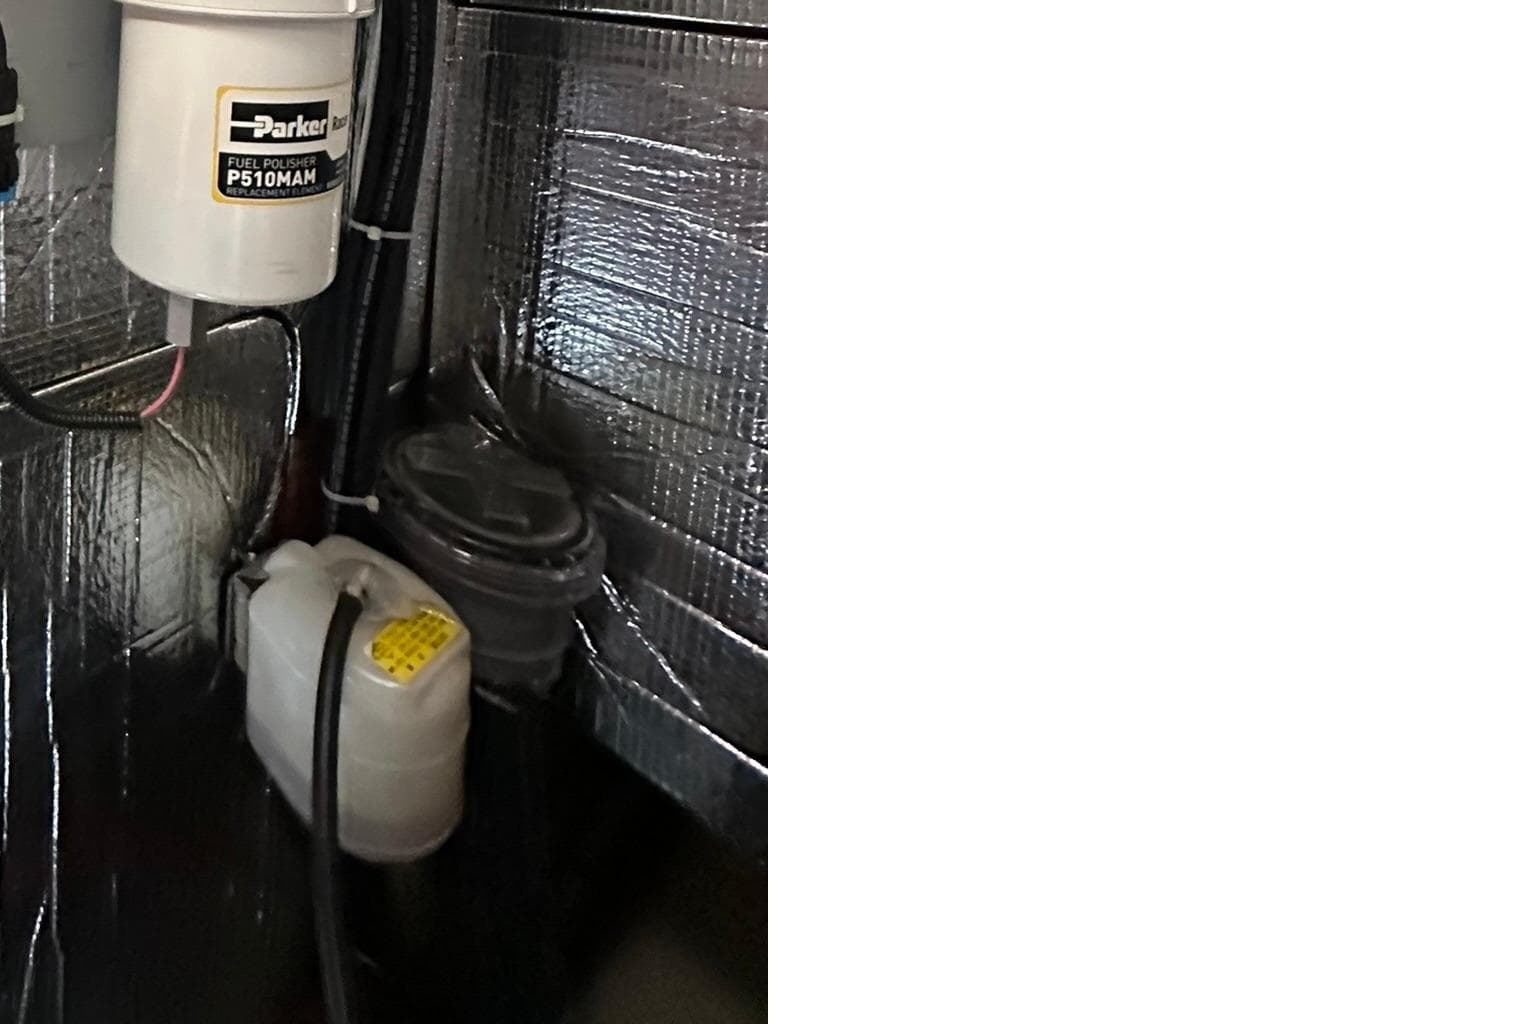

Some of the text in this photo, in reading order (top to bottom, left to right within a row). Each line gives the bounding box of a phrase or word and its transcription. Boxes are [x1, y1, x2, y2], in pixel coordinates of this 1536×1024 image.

[252, 114, 329, 139] Parker
[228, 156, 317, 169] FUEL POLISHER
[226, 167, 317, 188] P510MAM
[226, 187, 291, 198] REPLACEMENT
